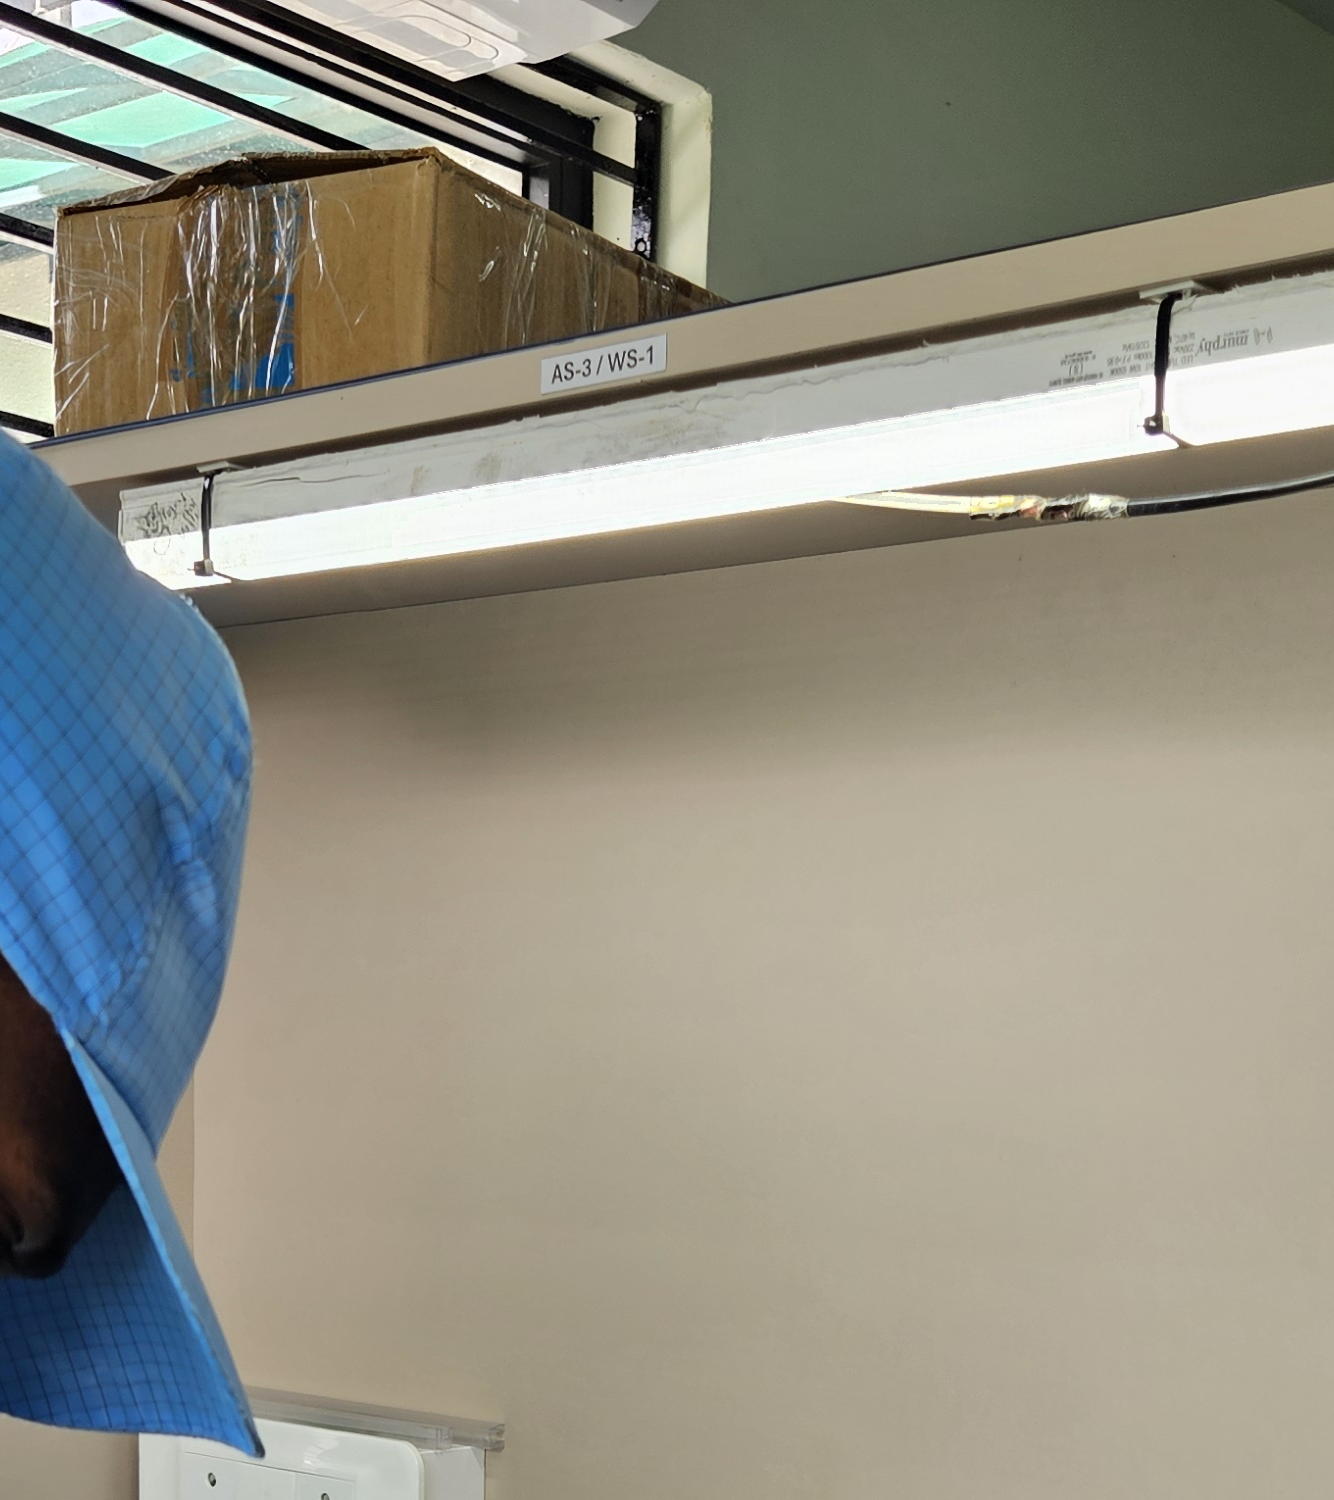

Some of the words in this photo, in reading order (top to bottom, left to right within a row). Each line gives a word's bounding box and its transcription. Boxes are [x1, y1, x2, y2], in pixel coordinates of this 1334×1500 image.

[1196, 334, 1249, 356] murphy
[551, 358, 592, 385] AS-3
[596, 355, 604, 376] /
[607, 344, 654, 373] WS-1
